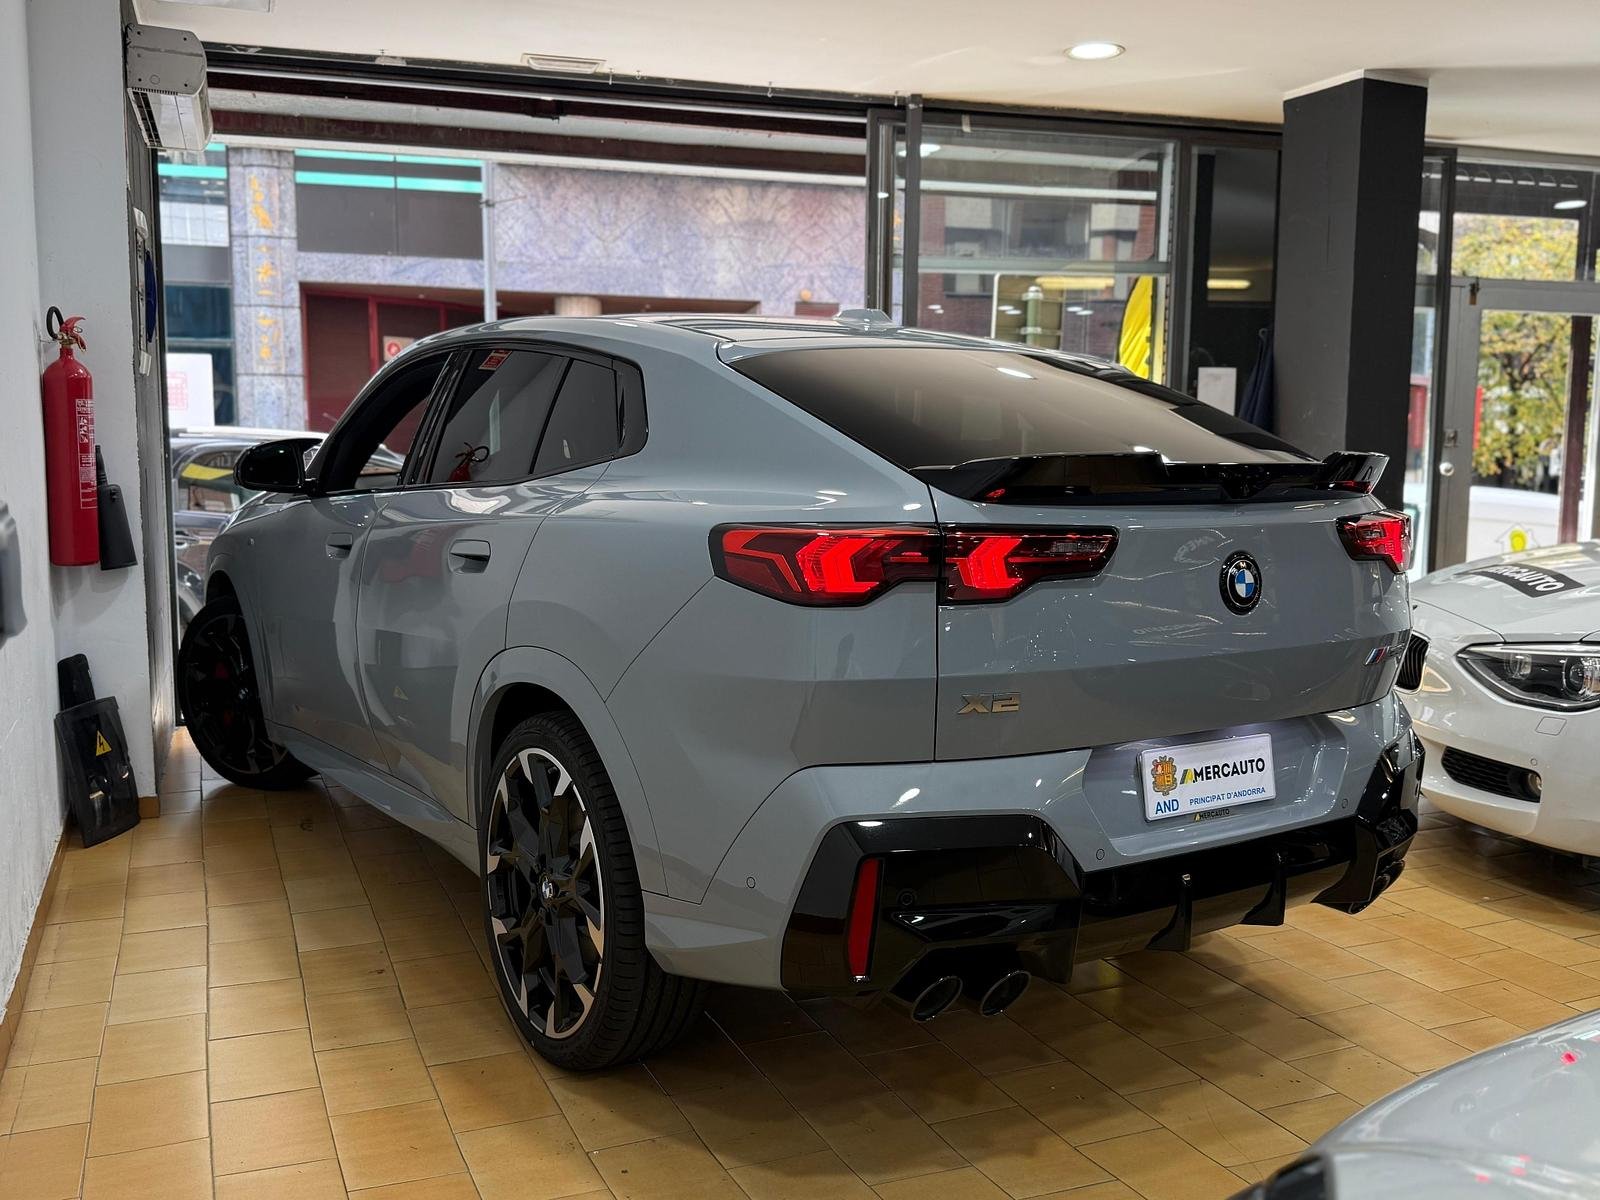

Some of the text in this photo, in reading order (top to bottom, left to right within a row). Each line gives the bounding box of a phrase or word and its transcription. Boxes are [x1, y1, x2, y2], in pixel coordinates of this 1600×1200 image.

[957, 691, 1022, 715] X2
[1192, 757, 1266, 783] MERCAUTO
[1189, 786, 1266, 806] PRINCIPAT D'ANDORRA
[1154, 798, 1180, 815] AND
[1199, 808, 1231, 820] MERCAUTO
